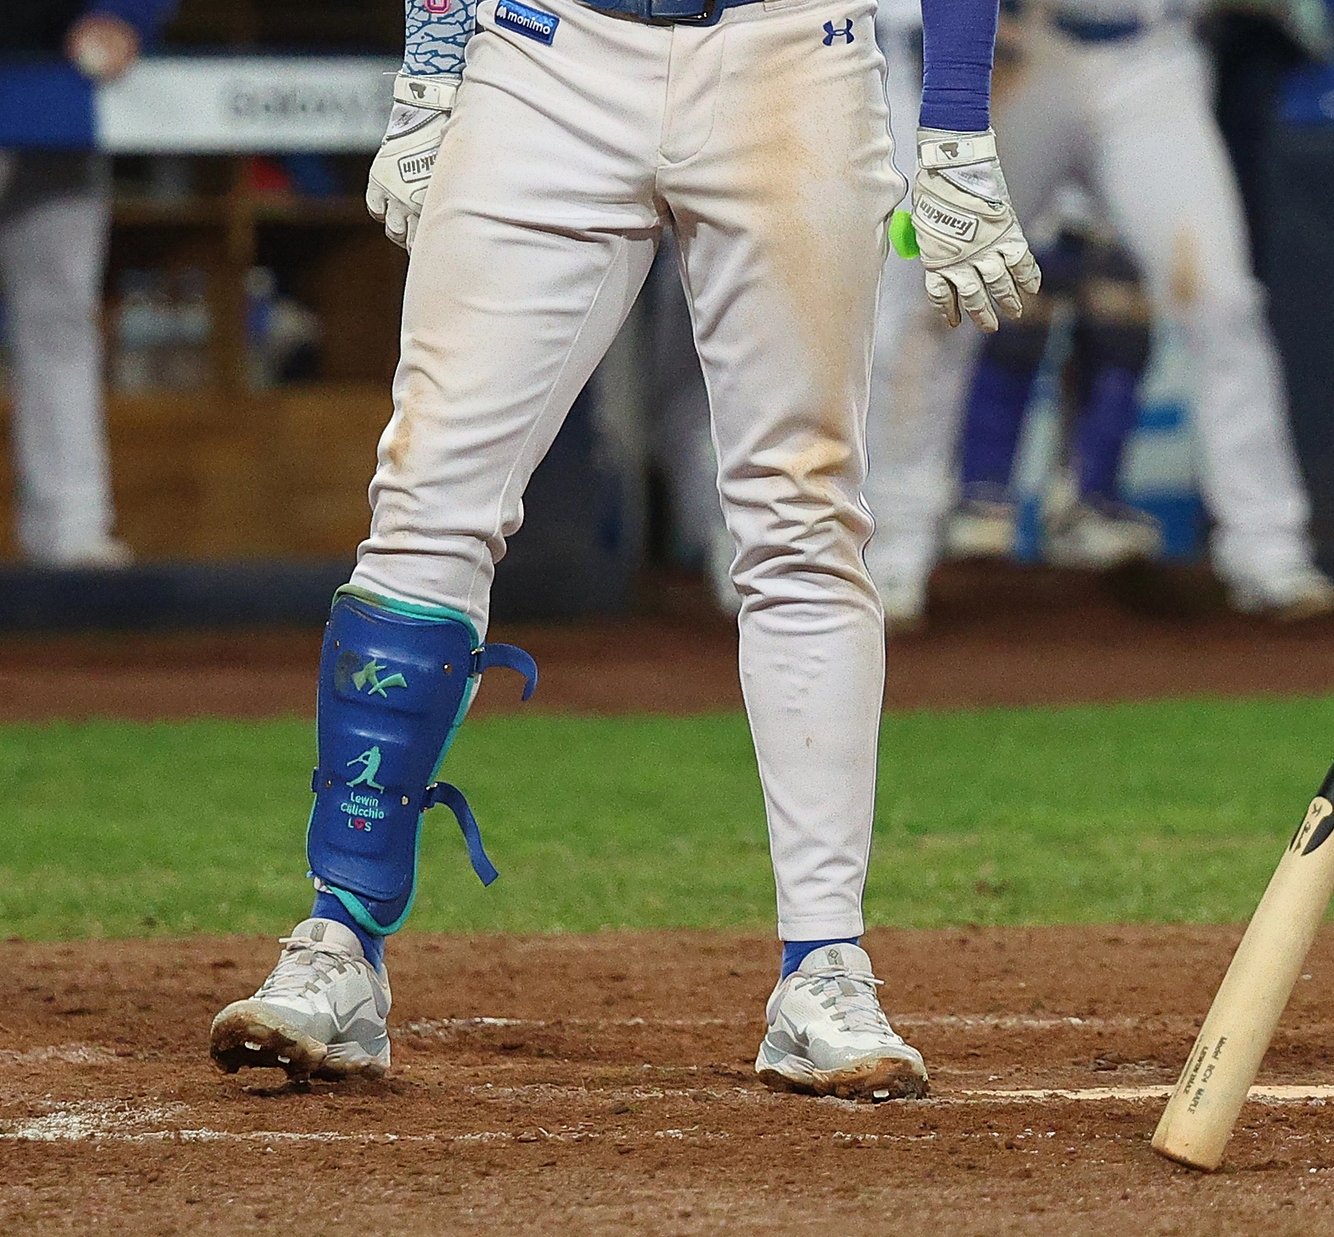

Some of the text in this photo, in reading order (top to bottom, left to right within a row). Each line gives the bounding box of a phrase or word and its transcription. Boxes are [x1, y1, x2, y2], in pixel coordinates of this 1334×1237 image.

[506, 10, 552, 35] monimo
[340, 802, 385, 820] Calicchio
[350, 791, 379, 807] Lewin
[1212, 1035, 1228, 1060] Model
[1187, 1087, 1205, 1115] MAPLE
